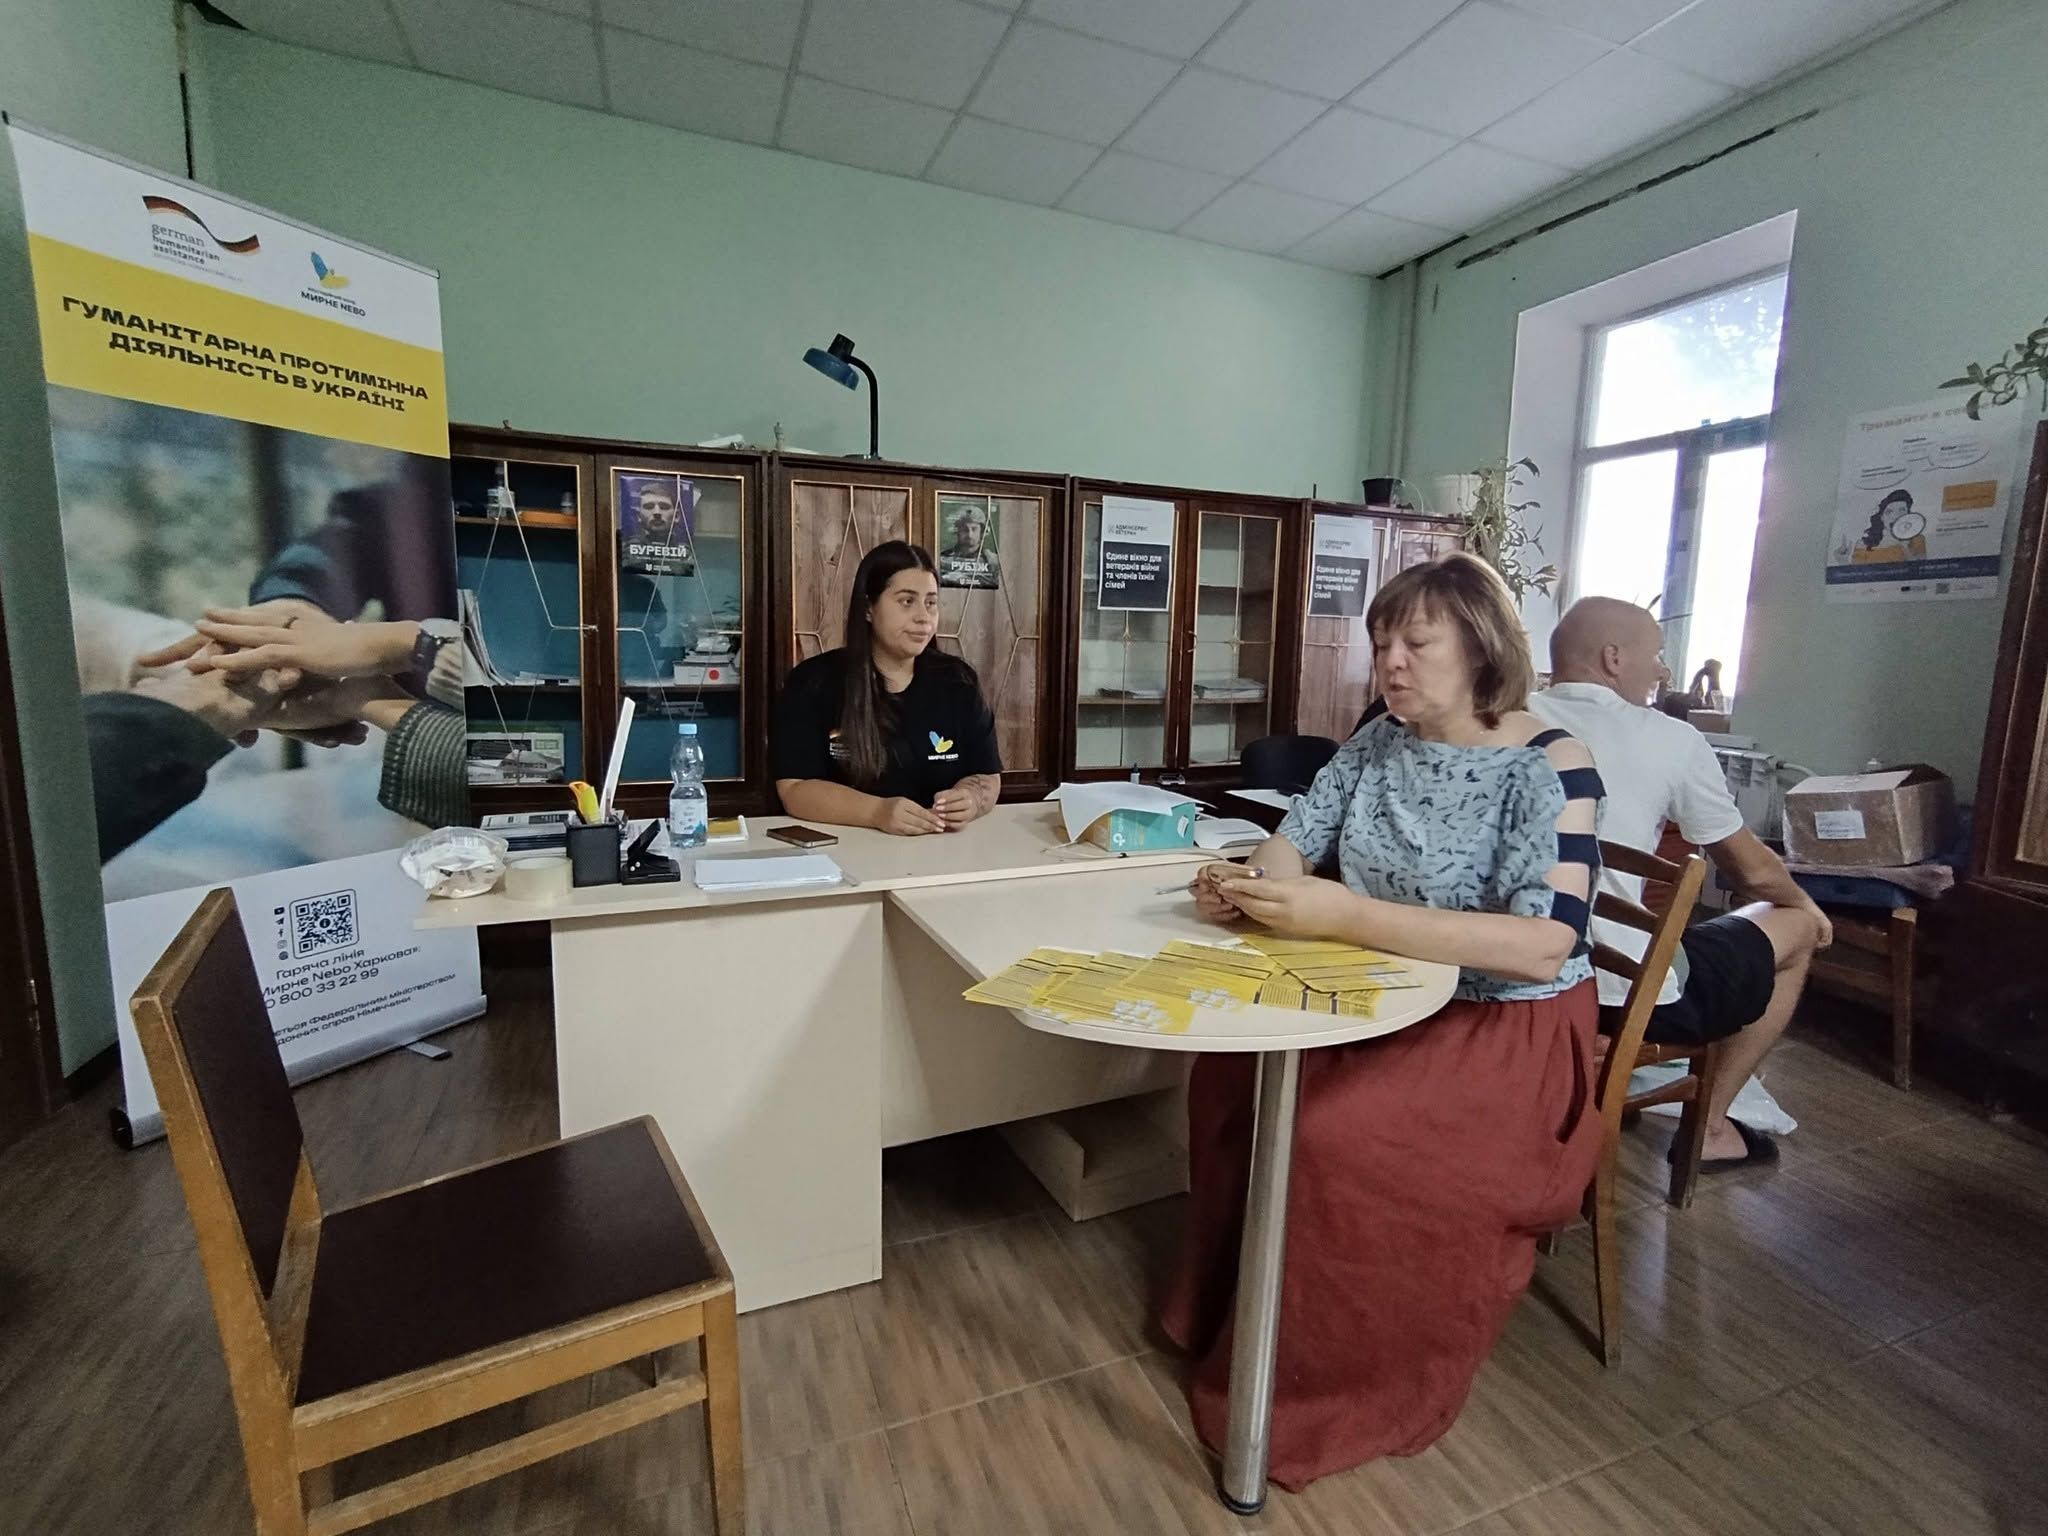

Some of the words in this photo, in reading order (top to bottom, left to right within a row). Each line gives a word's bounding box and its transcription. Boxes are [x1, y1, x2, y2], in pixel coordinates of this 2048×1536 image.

[152, 223, 205, 247] german
[153, 235, 220, 261] humanitarian
[153, 244, 205, 264] assistance
[301, 291, 339, 308] МИРНЕ
[62, 296, 276, 363] ГУМАНІТАРНА
[280, 352, 428, 399] ПРОТИМІННА
[109, 332, 289, 384] ДІЯЛЬНІСТЬ
[292, 375, 308, 389] В
[312, 379, 405, 411] УКРАЇНІ
[629, 544, 687, 557] БУРЕВІЙ
[276, 959, 329, 980] Гаряча
[332, 949, 365, 965] лінія
[312, 965, 351, 982] Nebo
[279, 987, 313, 1005] 800
[316, 980, 336, 994] 33
[339, 974, 357, 987] 22
[360, 967, 379, 980] 99
